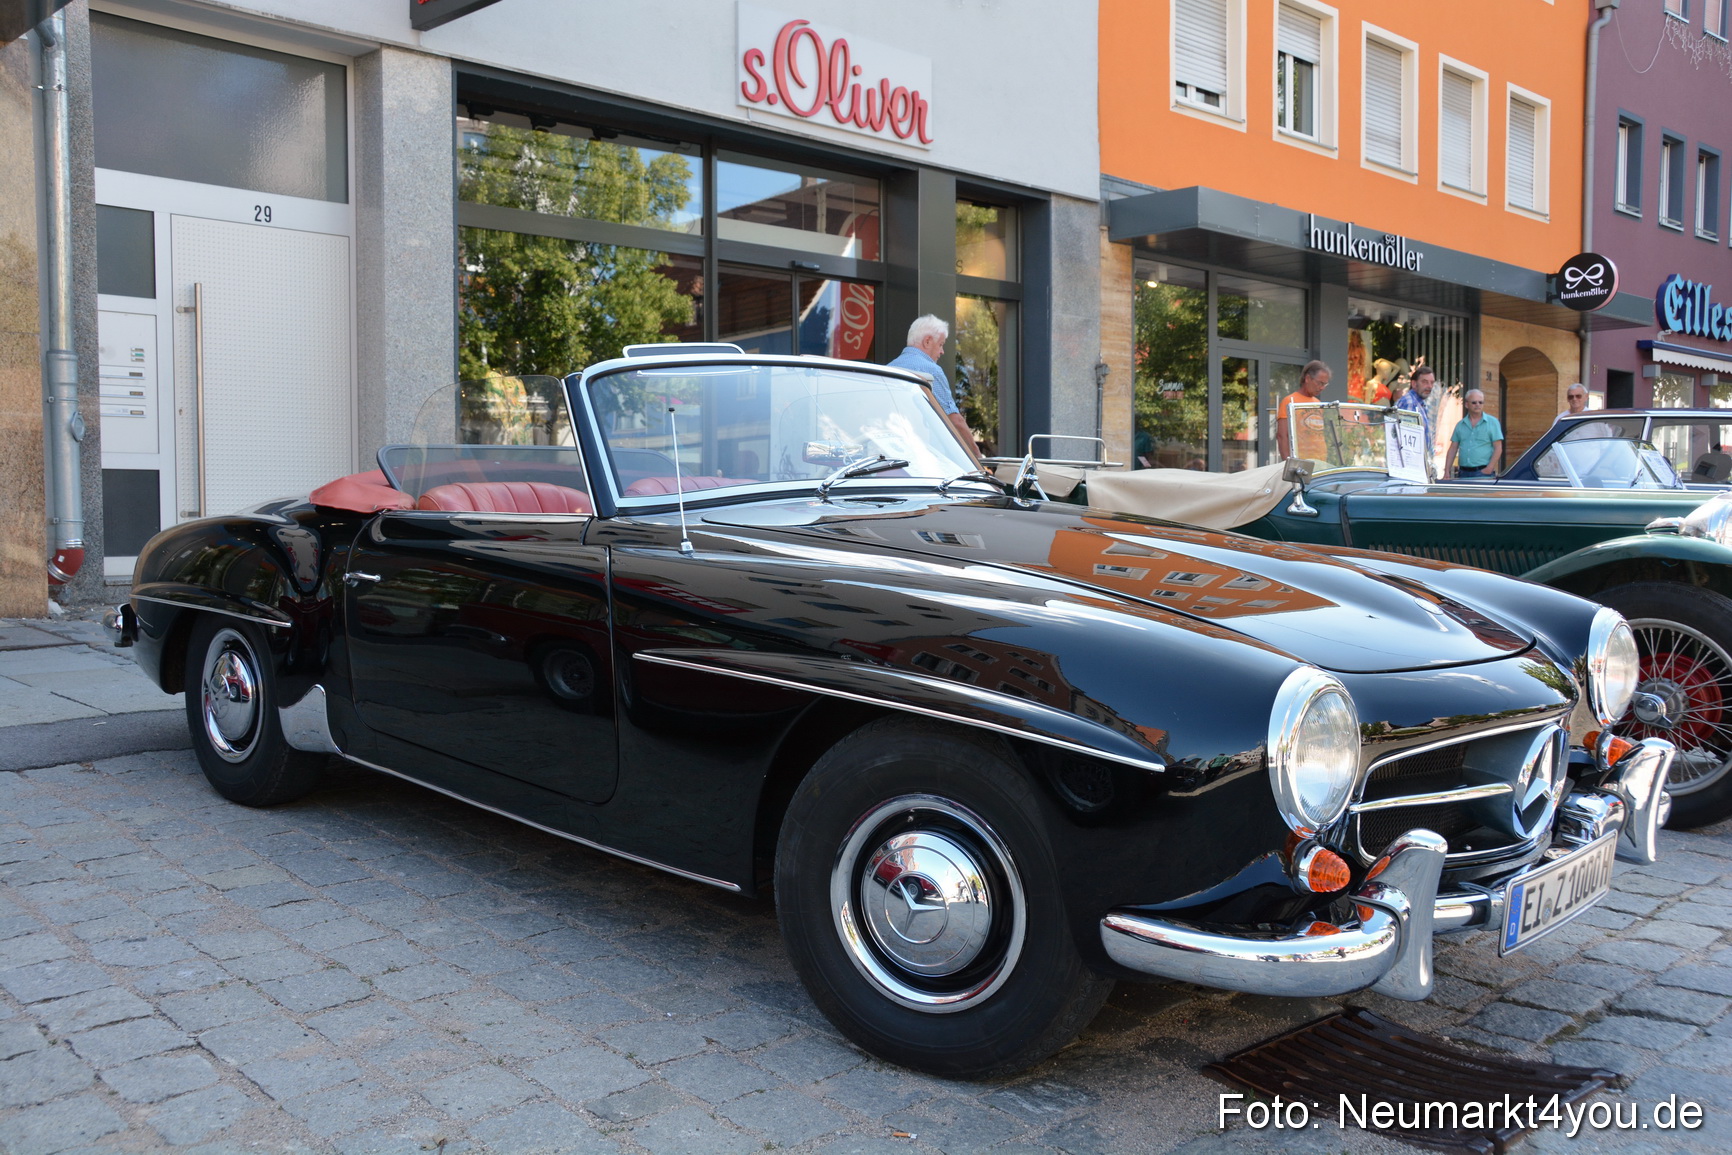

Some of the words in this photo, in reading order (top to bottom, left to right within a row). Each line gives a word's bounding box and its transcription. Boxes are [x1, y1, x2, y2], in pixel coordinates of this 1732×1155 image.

[741, 19, 934, 145] s.Oliver
[254, 205, 272, 223] 29
[1403, 434, 1417, 448] 147
[1521, 881, 1545, 934] EI
